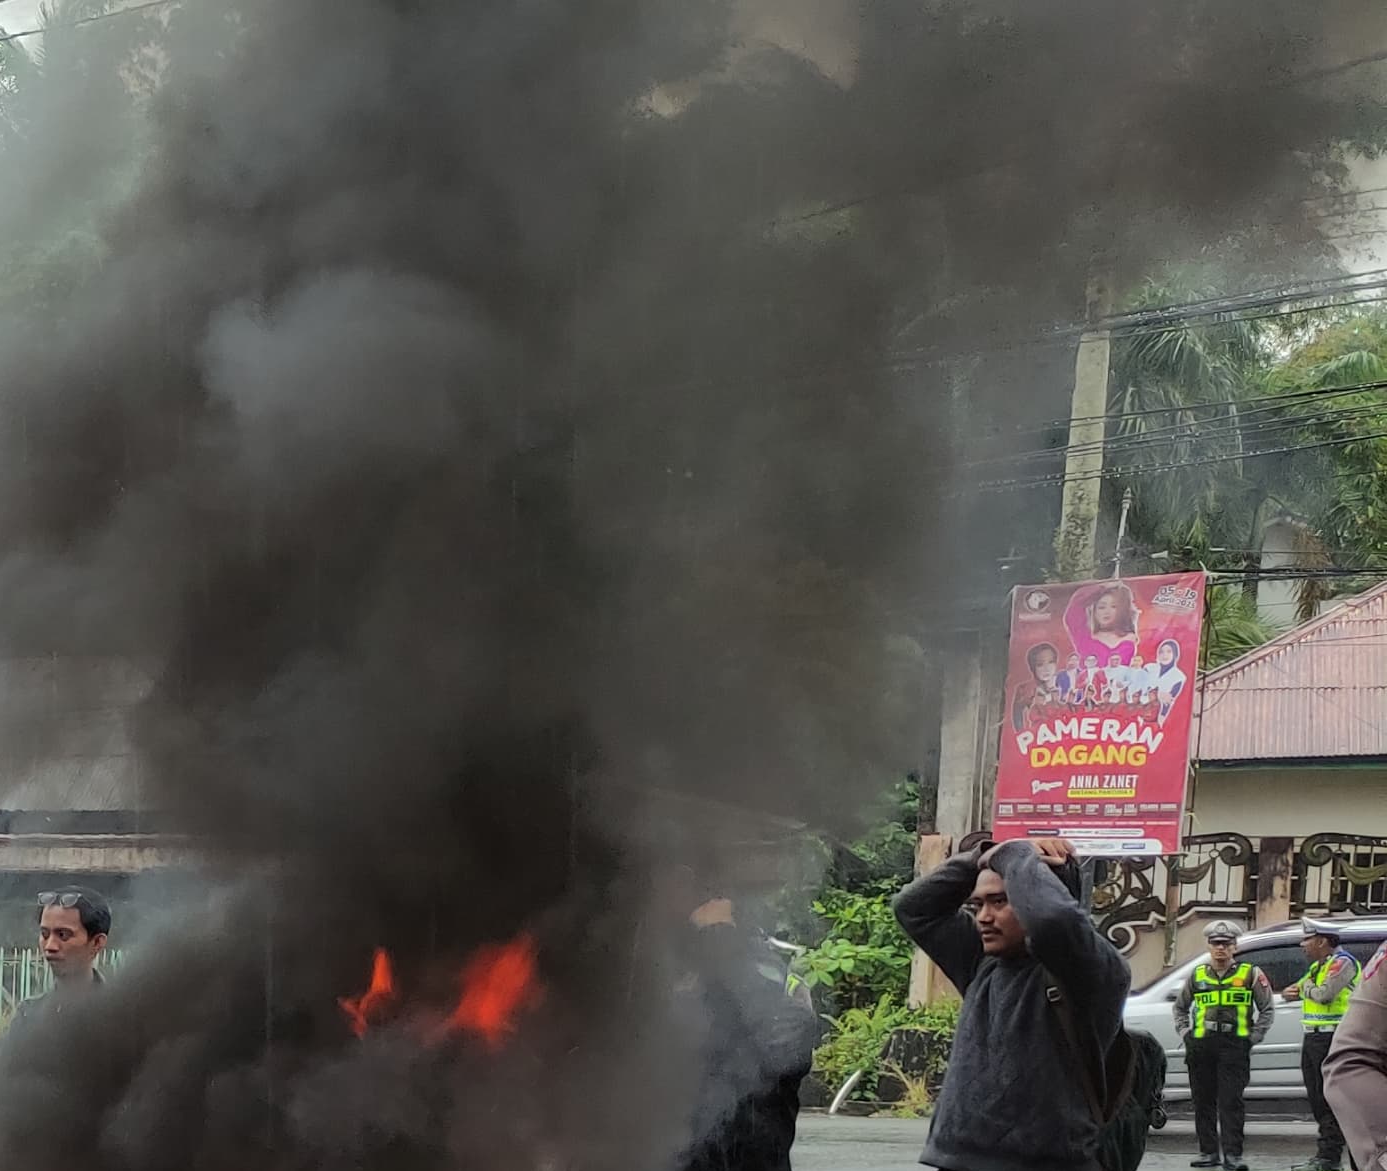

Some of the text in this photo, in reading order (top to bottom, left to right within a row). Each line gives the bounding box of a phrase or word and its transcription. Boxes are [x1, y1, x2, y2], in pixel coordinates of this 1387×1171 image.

[1184, 588, 1197, 600] 19
[1015, 714, 1164, 754] PAMERAN
[1029, 744, 1148, 769] DAGANG
[1068, 774, 1100, 789] ANNA
[1102, 774, 1139, 789] ZANET
